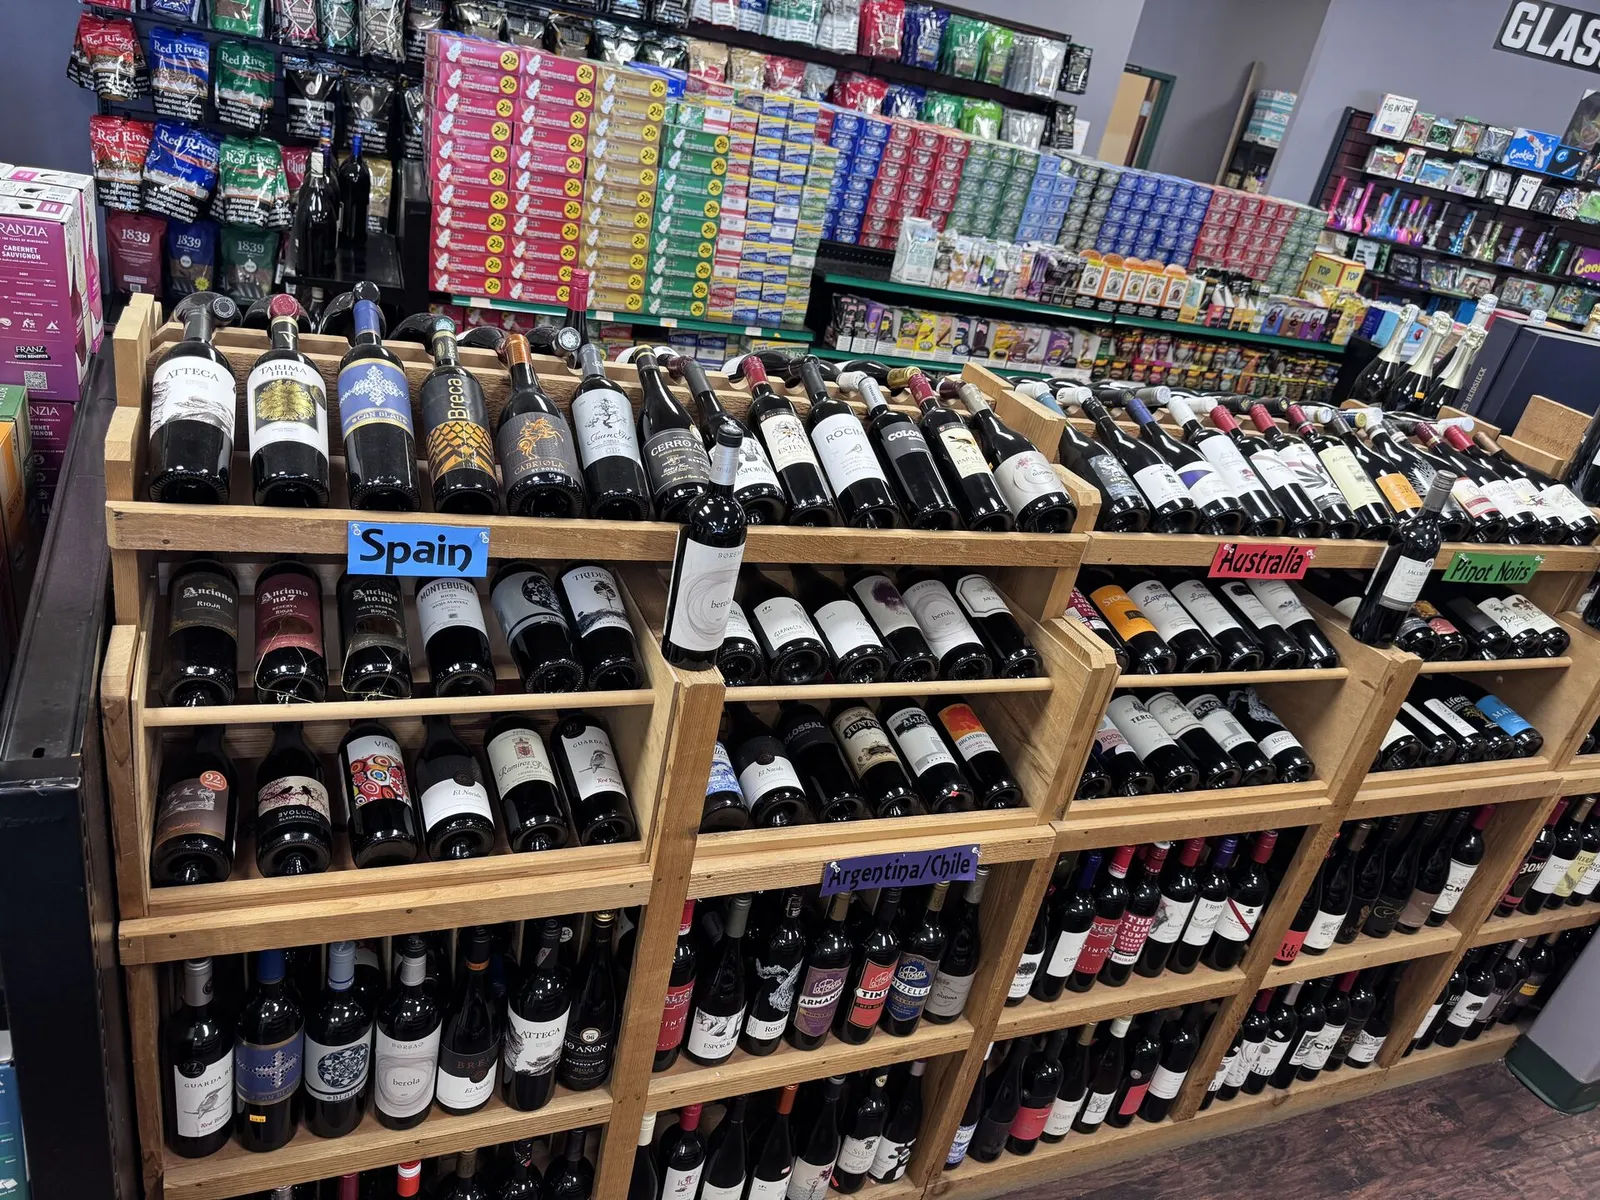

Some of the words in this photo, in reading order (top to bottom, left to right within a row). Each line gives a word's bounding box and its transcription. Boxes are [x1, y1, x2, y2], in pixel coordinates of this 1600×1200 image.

[87, 36, 102, 44] Red
[104, 35, 129, 44] River
[1501, 2, 1600, 69] GLAS
[154, 41, 172, 54] Red
[175, 44, 204, 57] River
[222, 51, 240, 64] Red
[242, 55, 267, 68] River
[1383, 102, 1394, 113] RIG
[1394, 104, 1400, 113] IN
[1400, 104, 1413, 114] ONE
[97, 129, 119, 142] Red
[122, 131, 151, 145] River
[160, 129, 182, 147] Red
[185, 136, 218, 158] River
[226, 150, 246, 164] Red
[249, 153, 278, 168] River
[1510, 148, 1536, 162] Cookies
[121, 228, 150, 244] 1839
[177, 234, 201, 248] 1839
[4, 244, 38, 254] CABERNET
[237, 240, 265, 254] 1839
[2, 251, 41, 260] SAUVIGNON
[1318, 265, 1330, 276] TOP
[1346, 272, 1360, 281] TOP
[16, 345, 44, 354] FRANZ
[164, 367, 220, 382] ATTECA
[259, 364, 307, 376] TARIMA
[1467, 366, 1488, 403] HEIDSIECK
[448, 378, 470, 420] Breca
[651, 440, 692, 456] CERRO
[514, 459, 566, 475] CABRIOLA
[360, 528, 472, 574] Spain
[1217, 544, 1304, 575] Australia
[1451, 556, 1494, 583] Pinot
[1500, 558, 1531, 582] Noirs
[182, 587, 233, 604] Anciano
[261, 587, 308, 605] Anciano
[352, 588, 398, 602] Anciano
[420, 580, 475, 601] MONTEBUENA
[932, 610, 956, 622] berola
[572, 739, 604, 748] GUARDA
[206, 772, 222, 786] 92
[828, 854, 970, 889] Argentina/Chile
[1128, 914, 1152, 925] THE
[520, 1027, 560, 1040] ATTECA
[184, 1075, 222, 1089] GUARDA
[392, 1078, 420, 1088] berola
